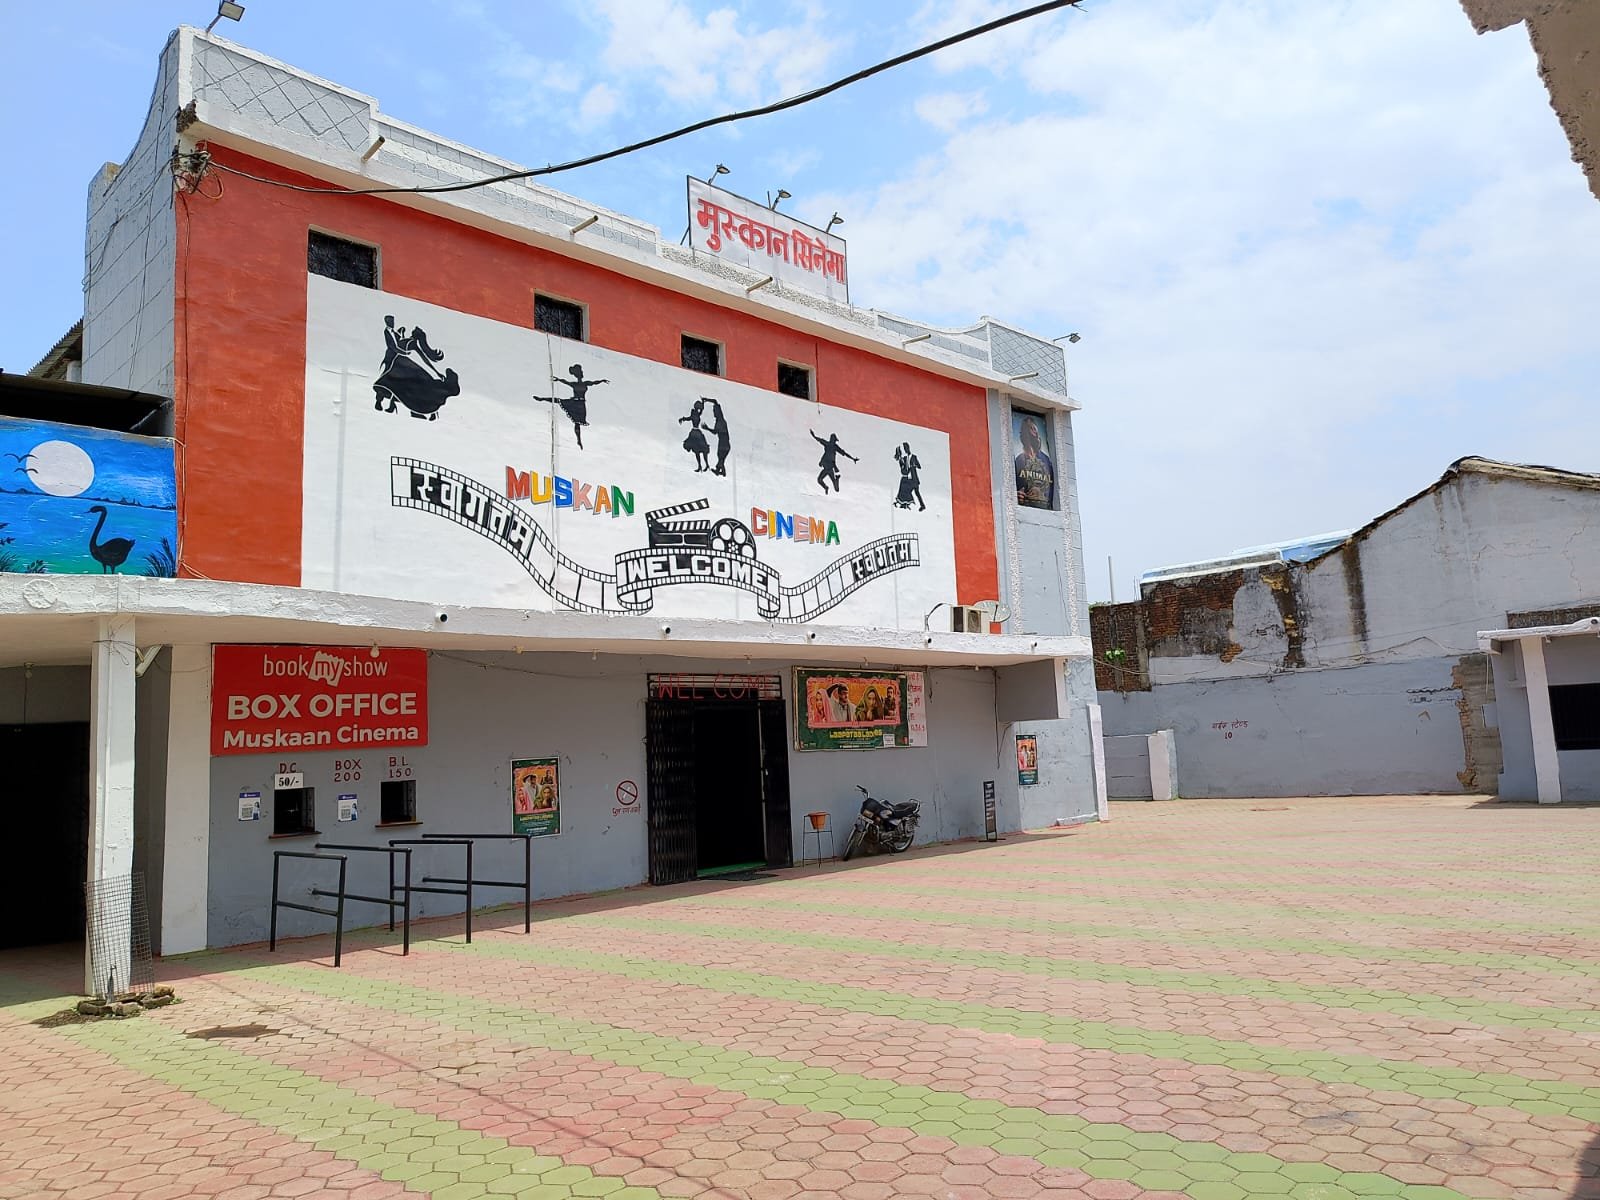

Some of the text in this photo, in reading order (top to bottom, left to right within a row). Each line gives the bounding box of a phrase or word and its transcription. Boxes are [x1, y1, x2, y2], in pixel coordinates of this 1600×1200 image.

[697, 198, 847, 285] मुस्कान सिनेमा
[1019, 470, 1053, 484] ANIMAL
[506, 465, 841, 546] MUSKAN CINEMA
[626, 555, 769, 589] WELCOME
[227, 692, 417, 720] BOX OFFICE
[223, 724, 419, 749] Muskaan Cinema
[335, 759, 362, 771] BOX
[389, 767, 412, 779] 150
[278, 776, 300, 787] 50/-
[334, 771, 361, 783] 200
